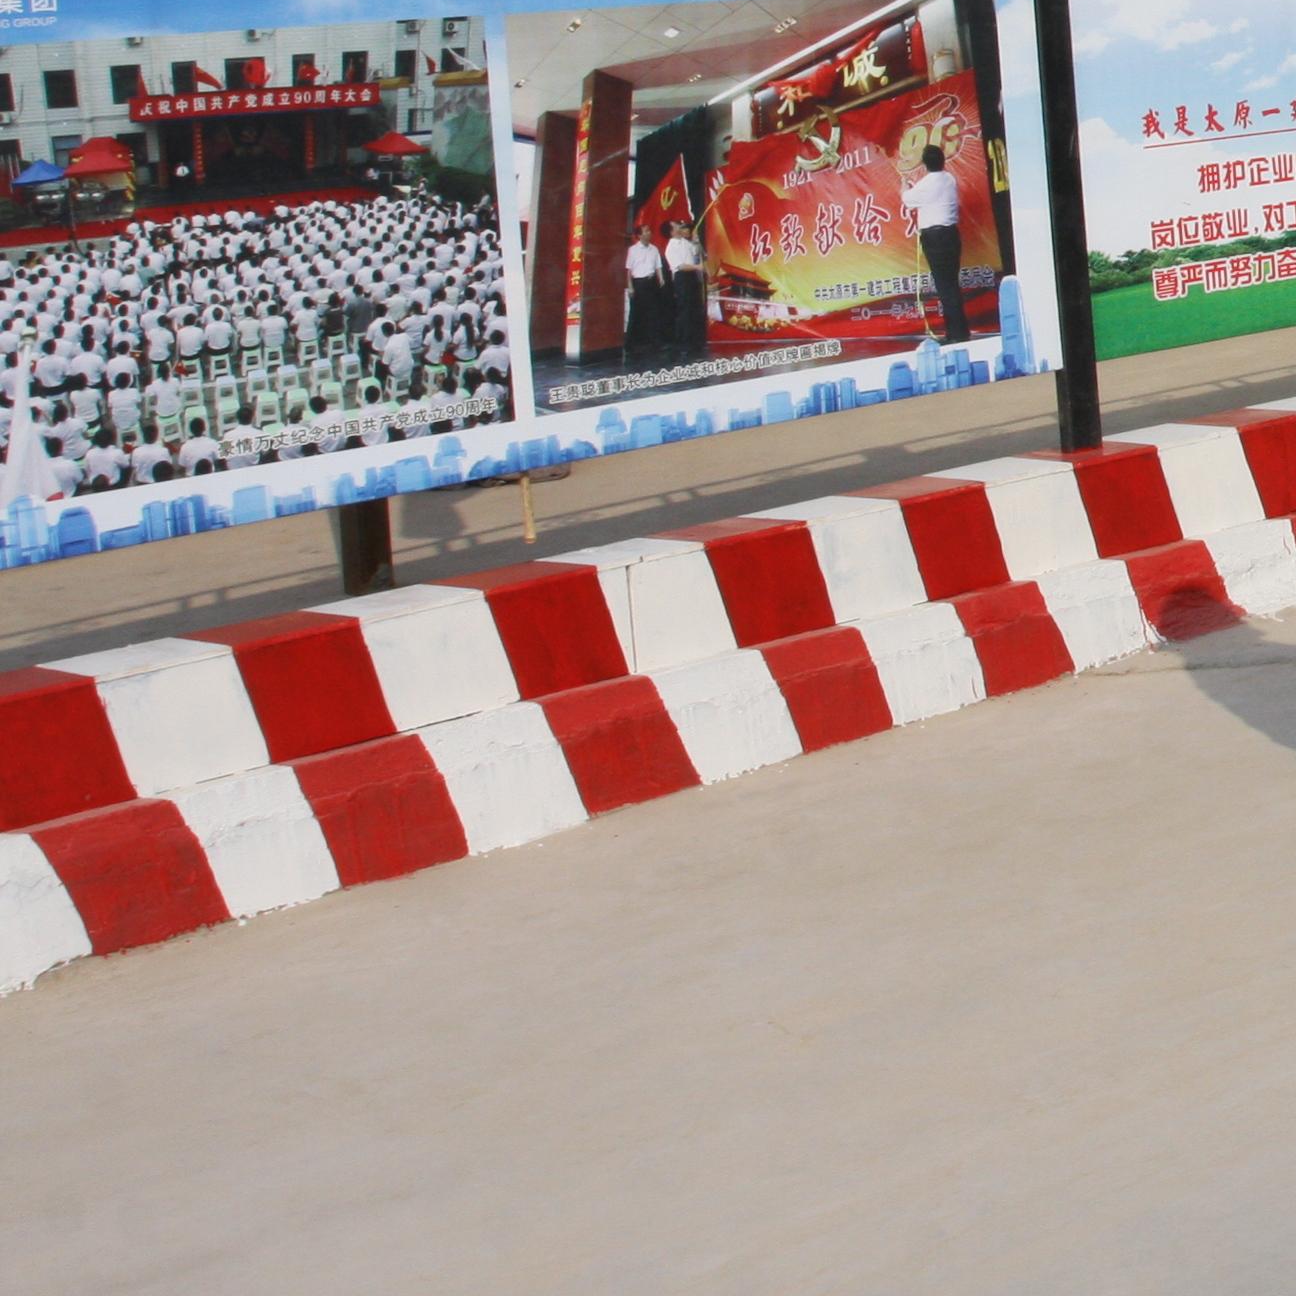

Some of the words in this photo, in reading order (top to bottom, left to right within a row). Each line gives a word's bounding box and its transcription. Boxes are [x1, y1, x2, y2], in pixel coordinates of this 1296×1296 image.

[139, 88, 374, 117] 庆祝中国共产党成立90周年大会
[217, 397, 498, 459] 豪情万丈纪念中国共产党成立90周年
